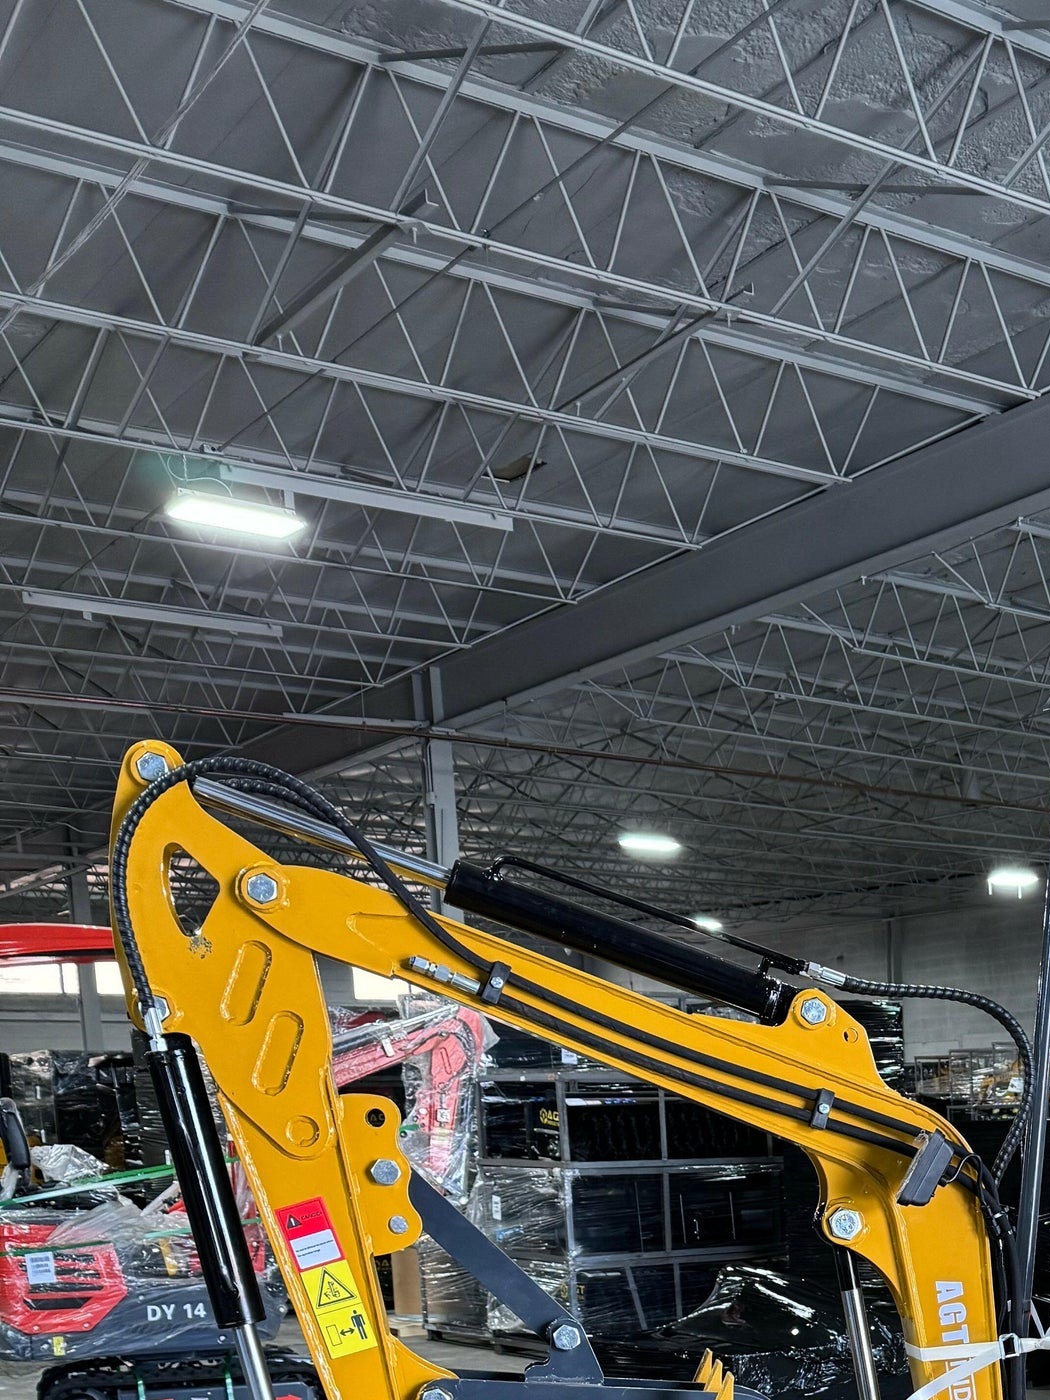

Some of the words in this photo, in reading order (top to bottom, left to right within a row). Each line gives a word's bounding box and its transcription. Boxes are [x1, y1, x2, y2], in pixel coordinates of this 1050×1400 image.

[147, 1304, 175, 1321] DY
[183, 1303, 207, 1319] 14
[935, 1280, 970, 1345] AGT
